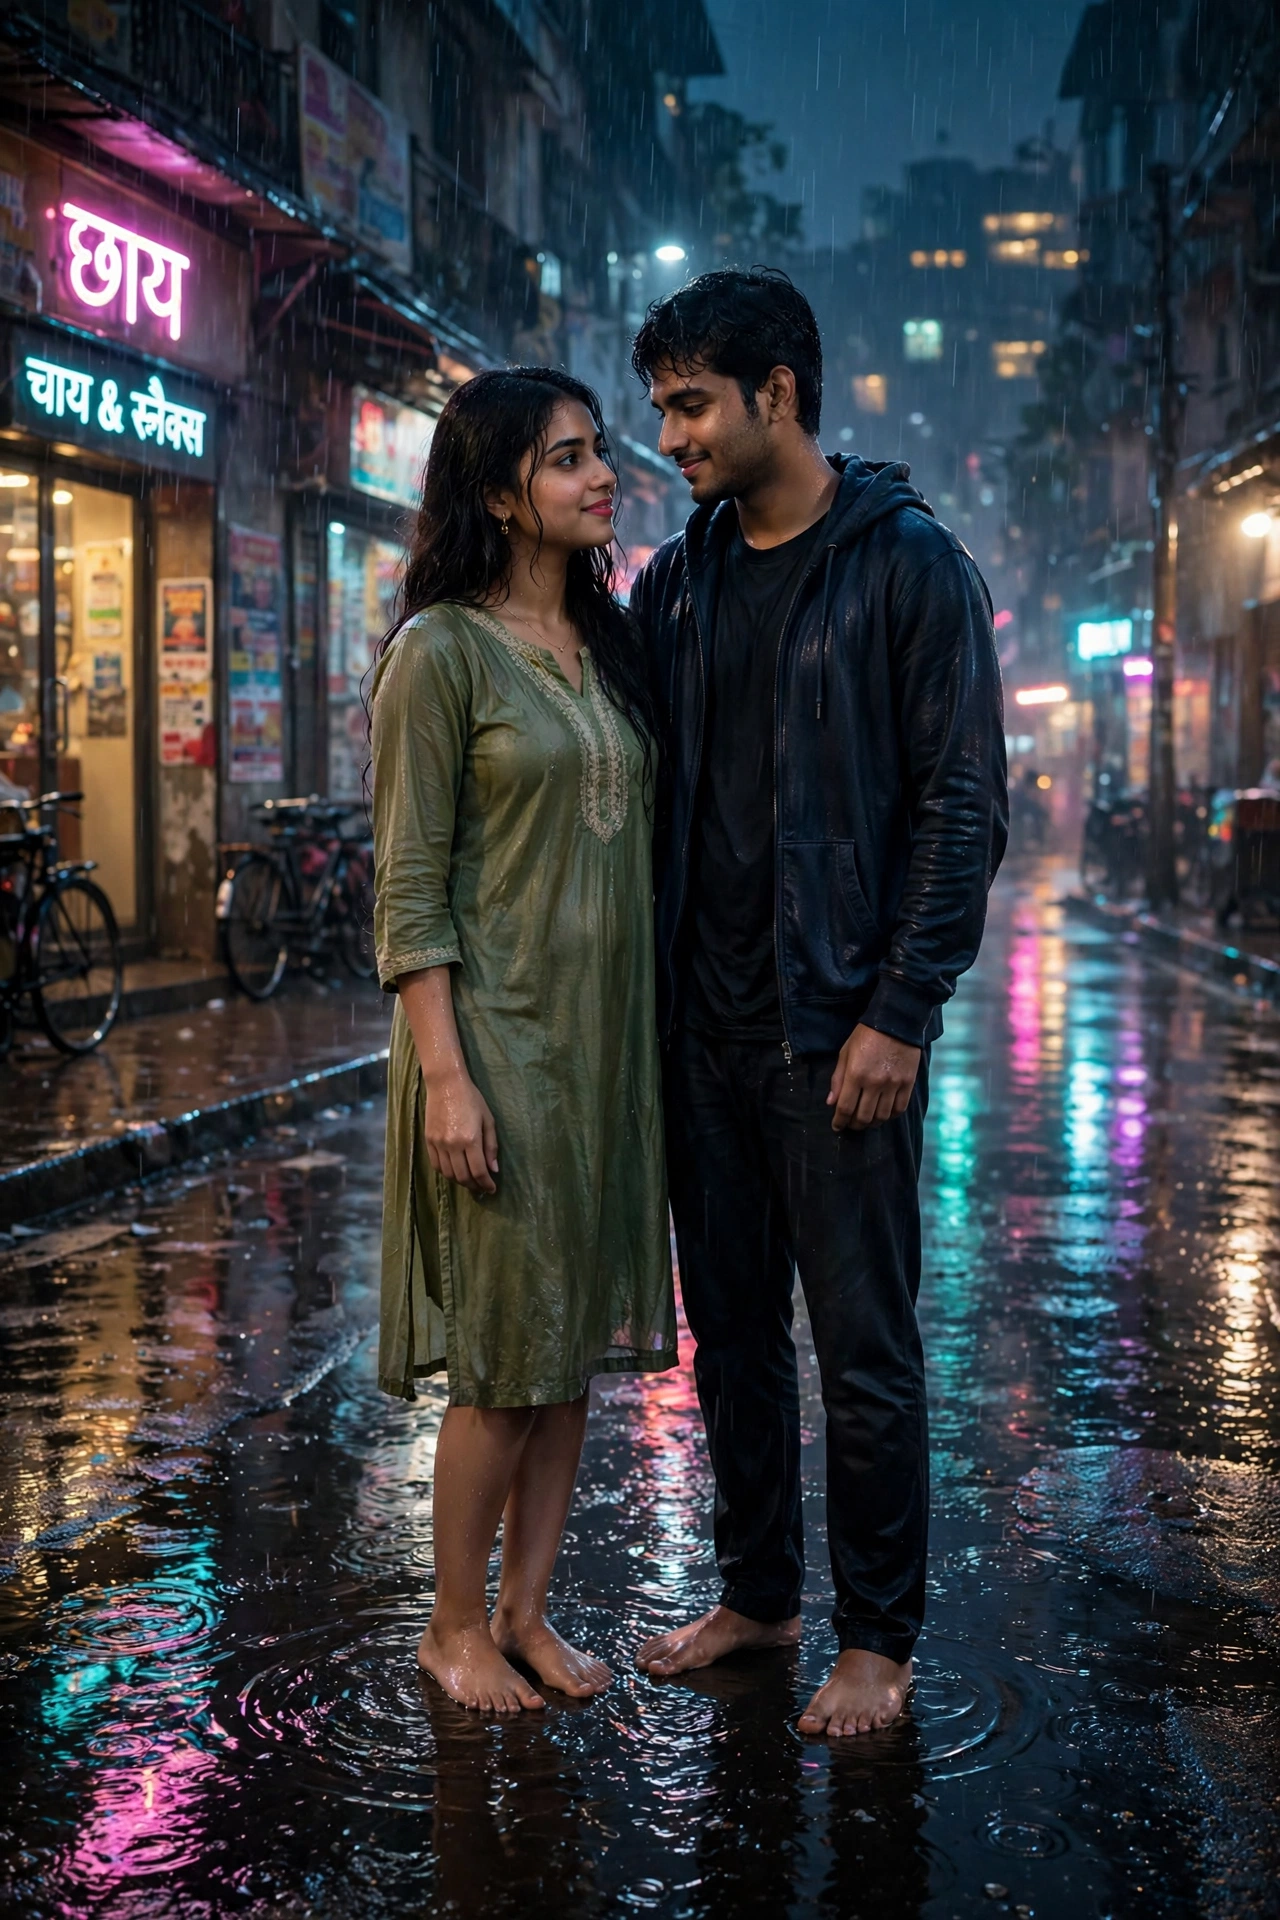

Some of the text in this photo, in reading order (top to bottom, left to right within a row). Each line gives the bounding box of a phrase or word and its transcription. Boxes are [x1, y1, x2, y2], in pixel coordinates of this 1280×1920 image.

[62, 202, 191, 341] छाय
[25, 356, 95, 425] चाय
[97, 379, 125, 434] &
